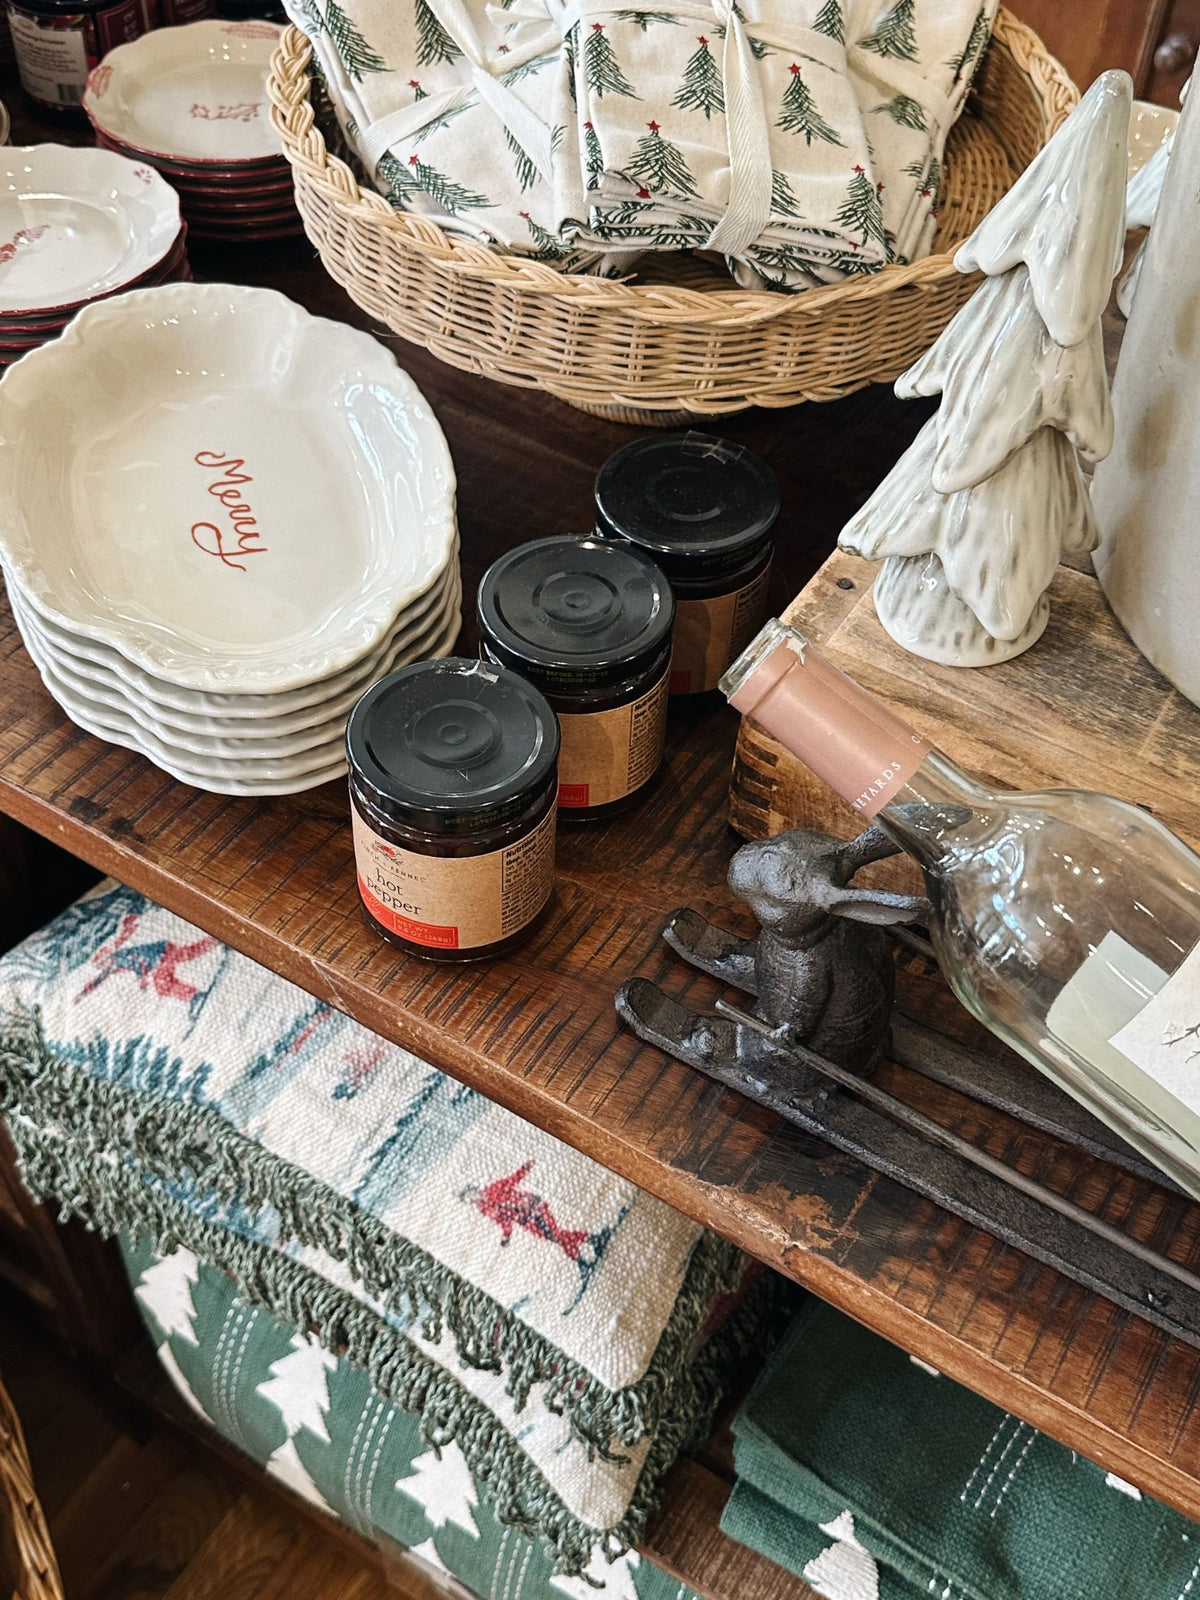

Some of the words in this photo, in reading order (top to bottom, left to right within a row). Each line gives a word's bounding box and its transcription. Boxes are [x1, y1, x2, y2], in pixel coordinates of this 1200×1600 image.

[190, 451, 268, 572] Merry
[850, 761, 902, 810] NEYARDS
[366, 875, 422, 915] pepper
[376, 867, 404, 896] hot
